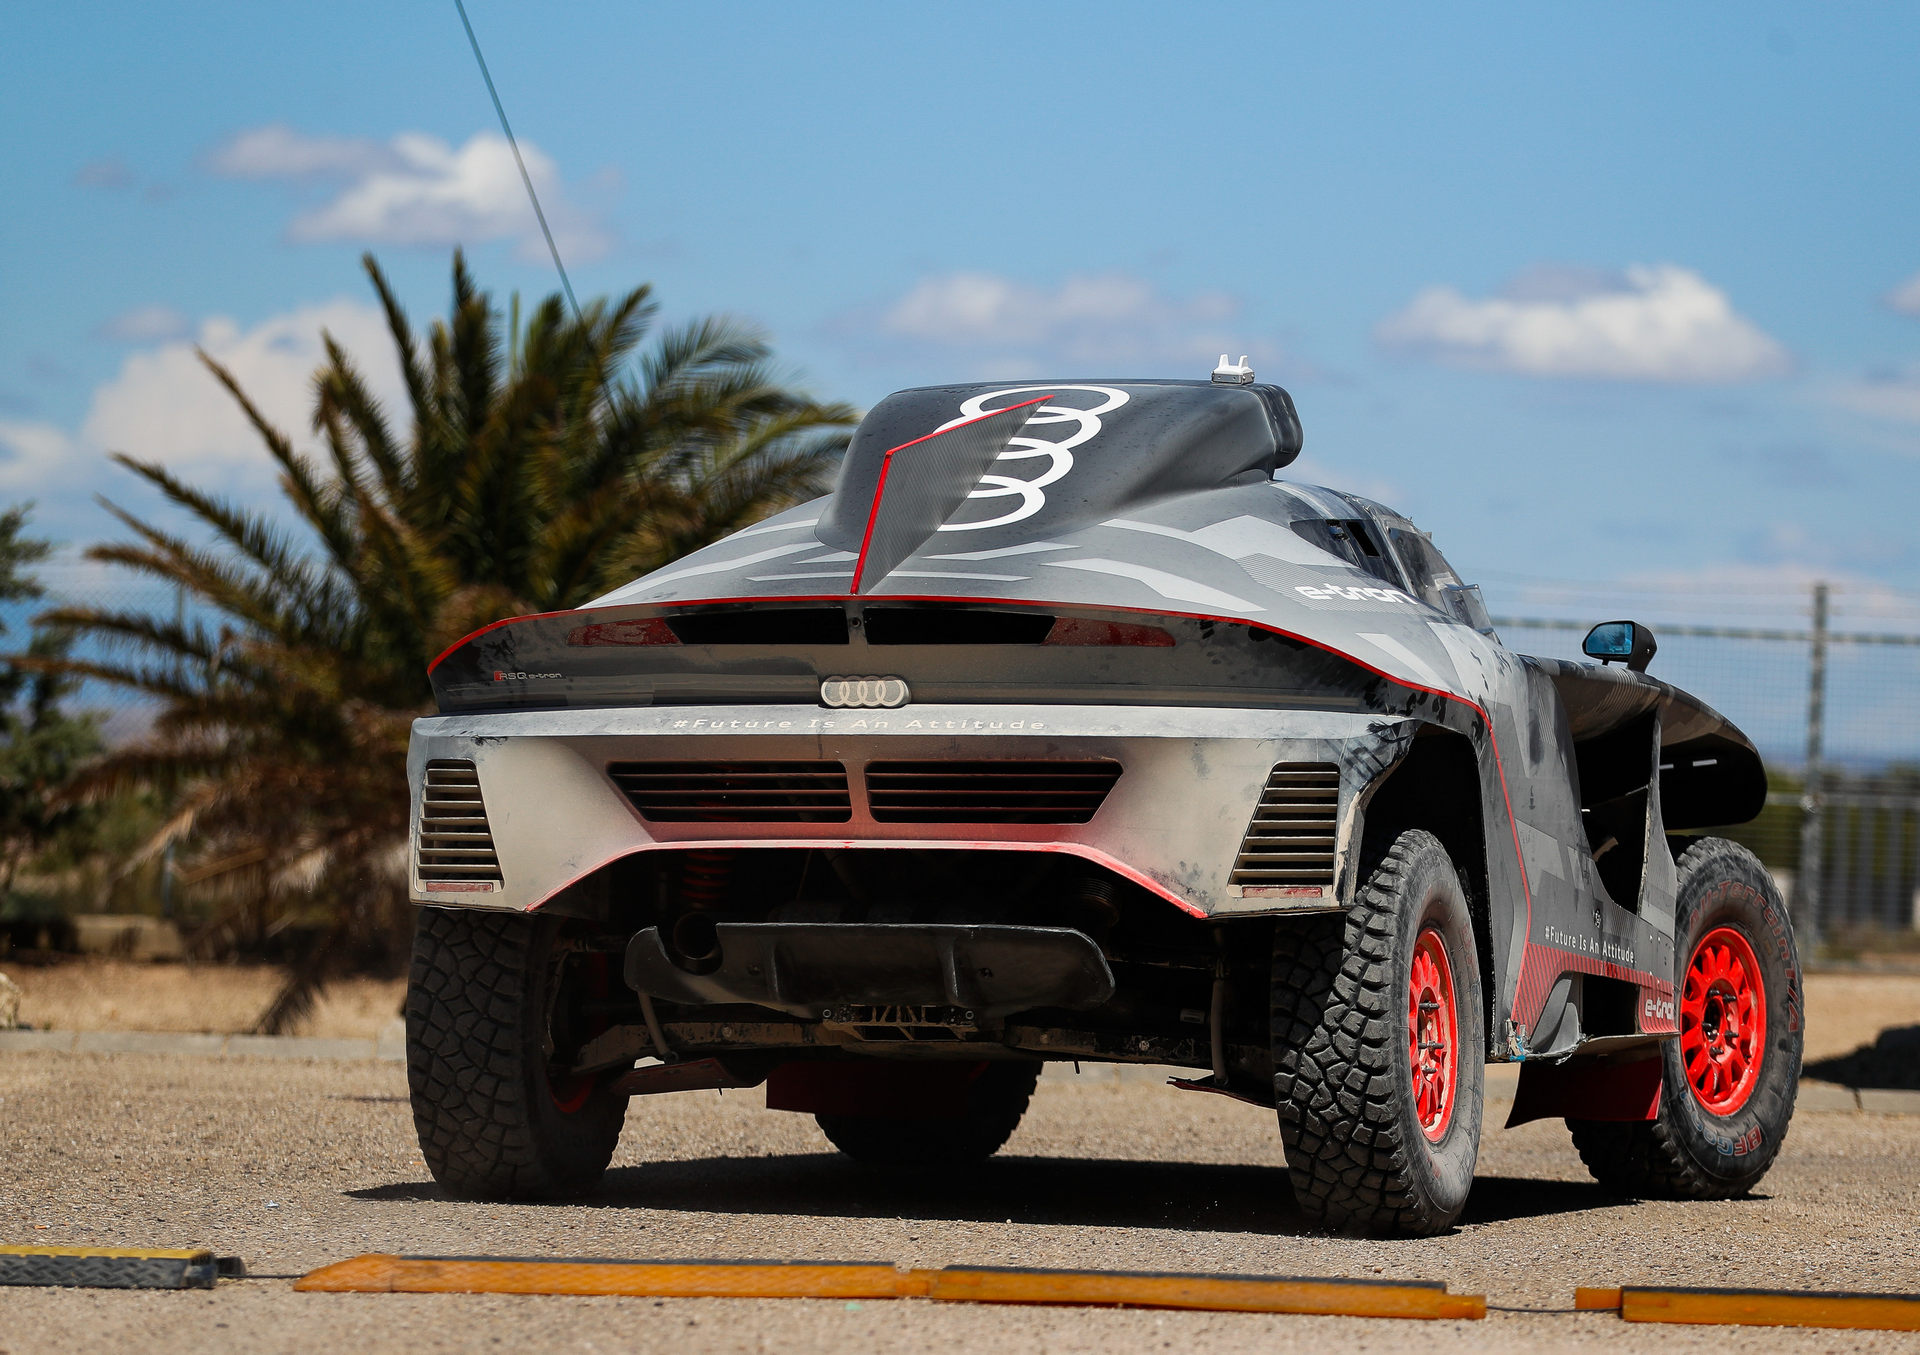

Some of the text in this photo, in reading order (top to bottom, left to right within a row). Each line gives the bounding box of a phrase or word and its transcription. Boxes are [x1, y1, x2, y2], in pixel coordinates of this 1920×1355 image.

[1294, 582, 1418, 605] e-tron
[499, 671, 528, 680] RSQ
[673, 719, 1045, 729] #Future Is An Attitude
[1545, 924, 1577, 949] #Future
[1579, 933, 1587, 954] Is
[1589, 937, 1600, 954] An
[1644, 997, 1674, 1020] e-tro
